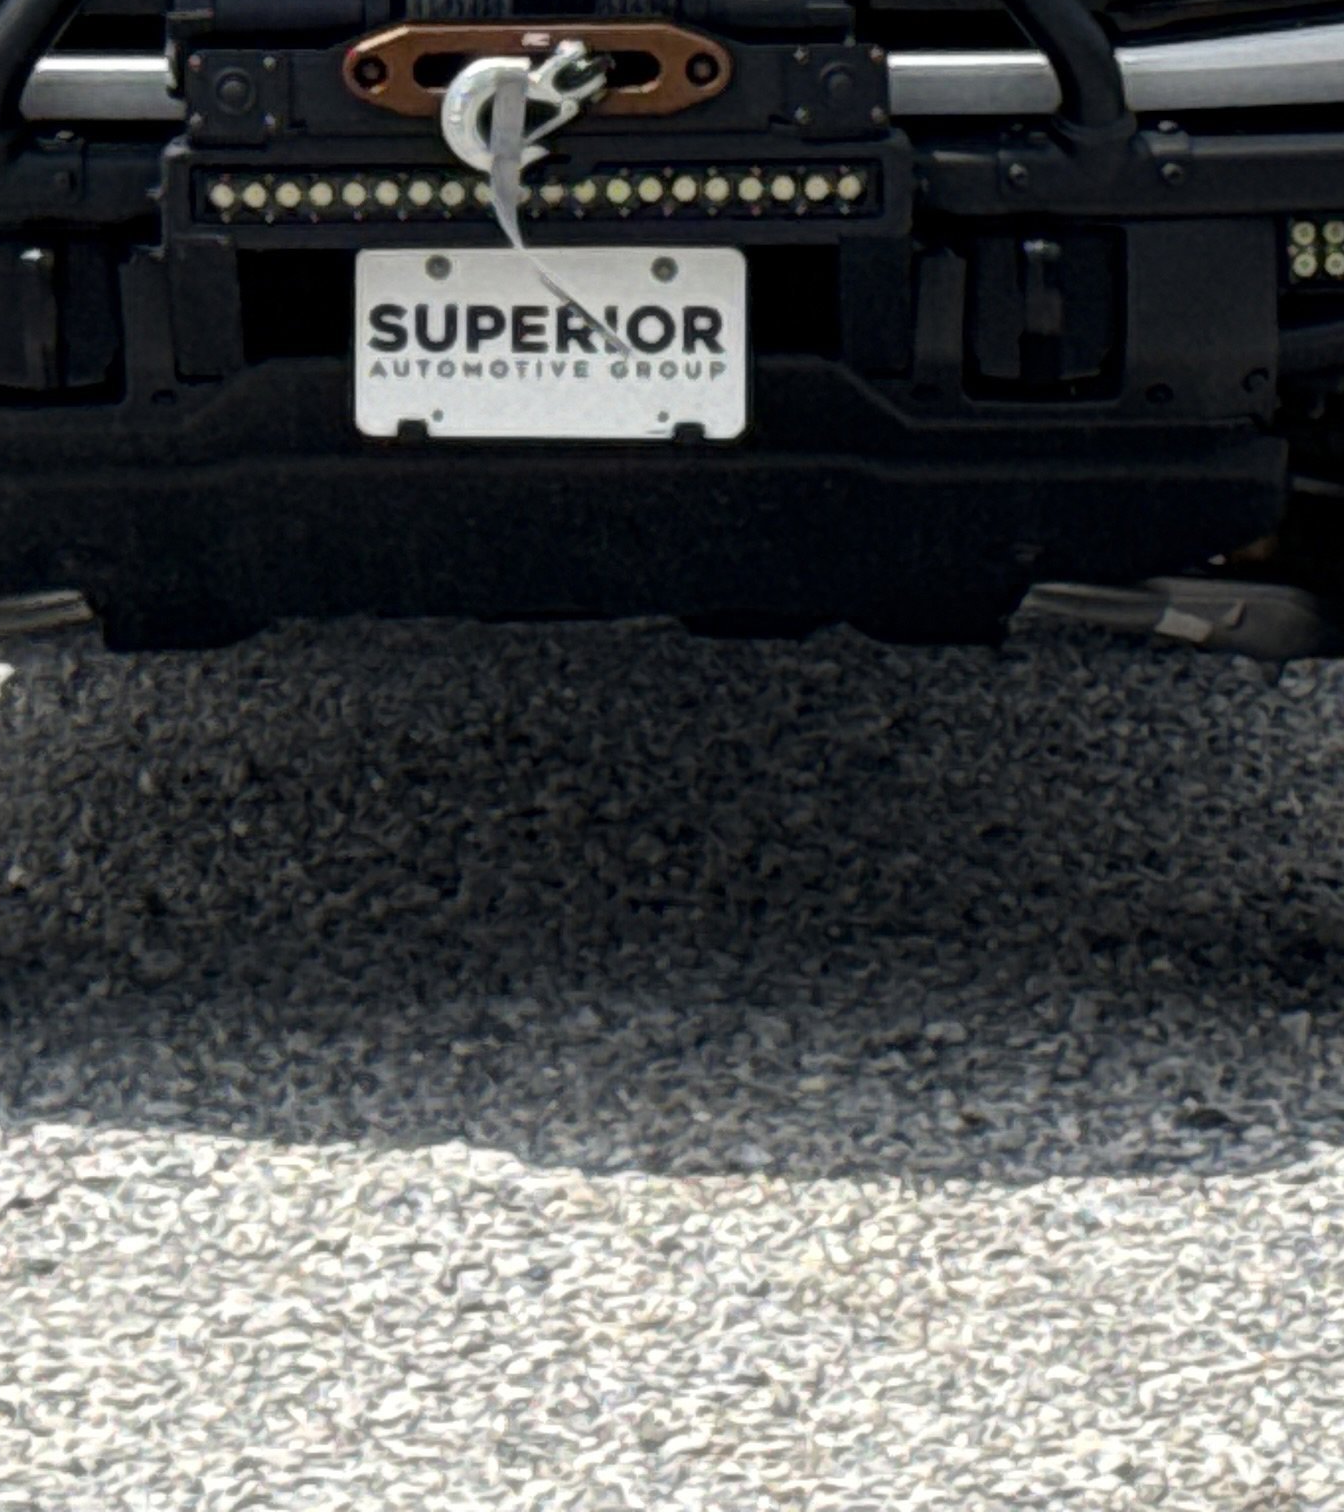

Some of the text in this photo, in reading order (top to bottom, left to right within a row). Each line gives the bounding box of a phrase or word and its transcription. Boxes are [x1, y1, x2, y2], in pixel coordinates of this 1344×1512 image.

[367, 303, 726, 354] SUPERIOR
[367, 359, 727, 381] AUTOMOTIVE GROUP
